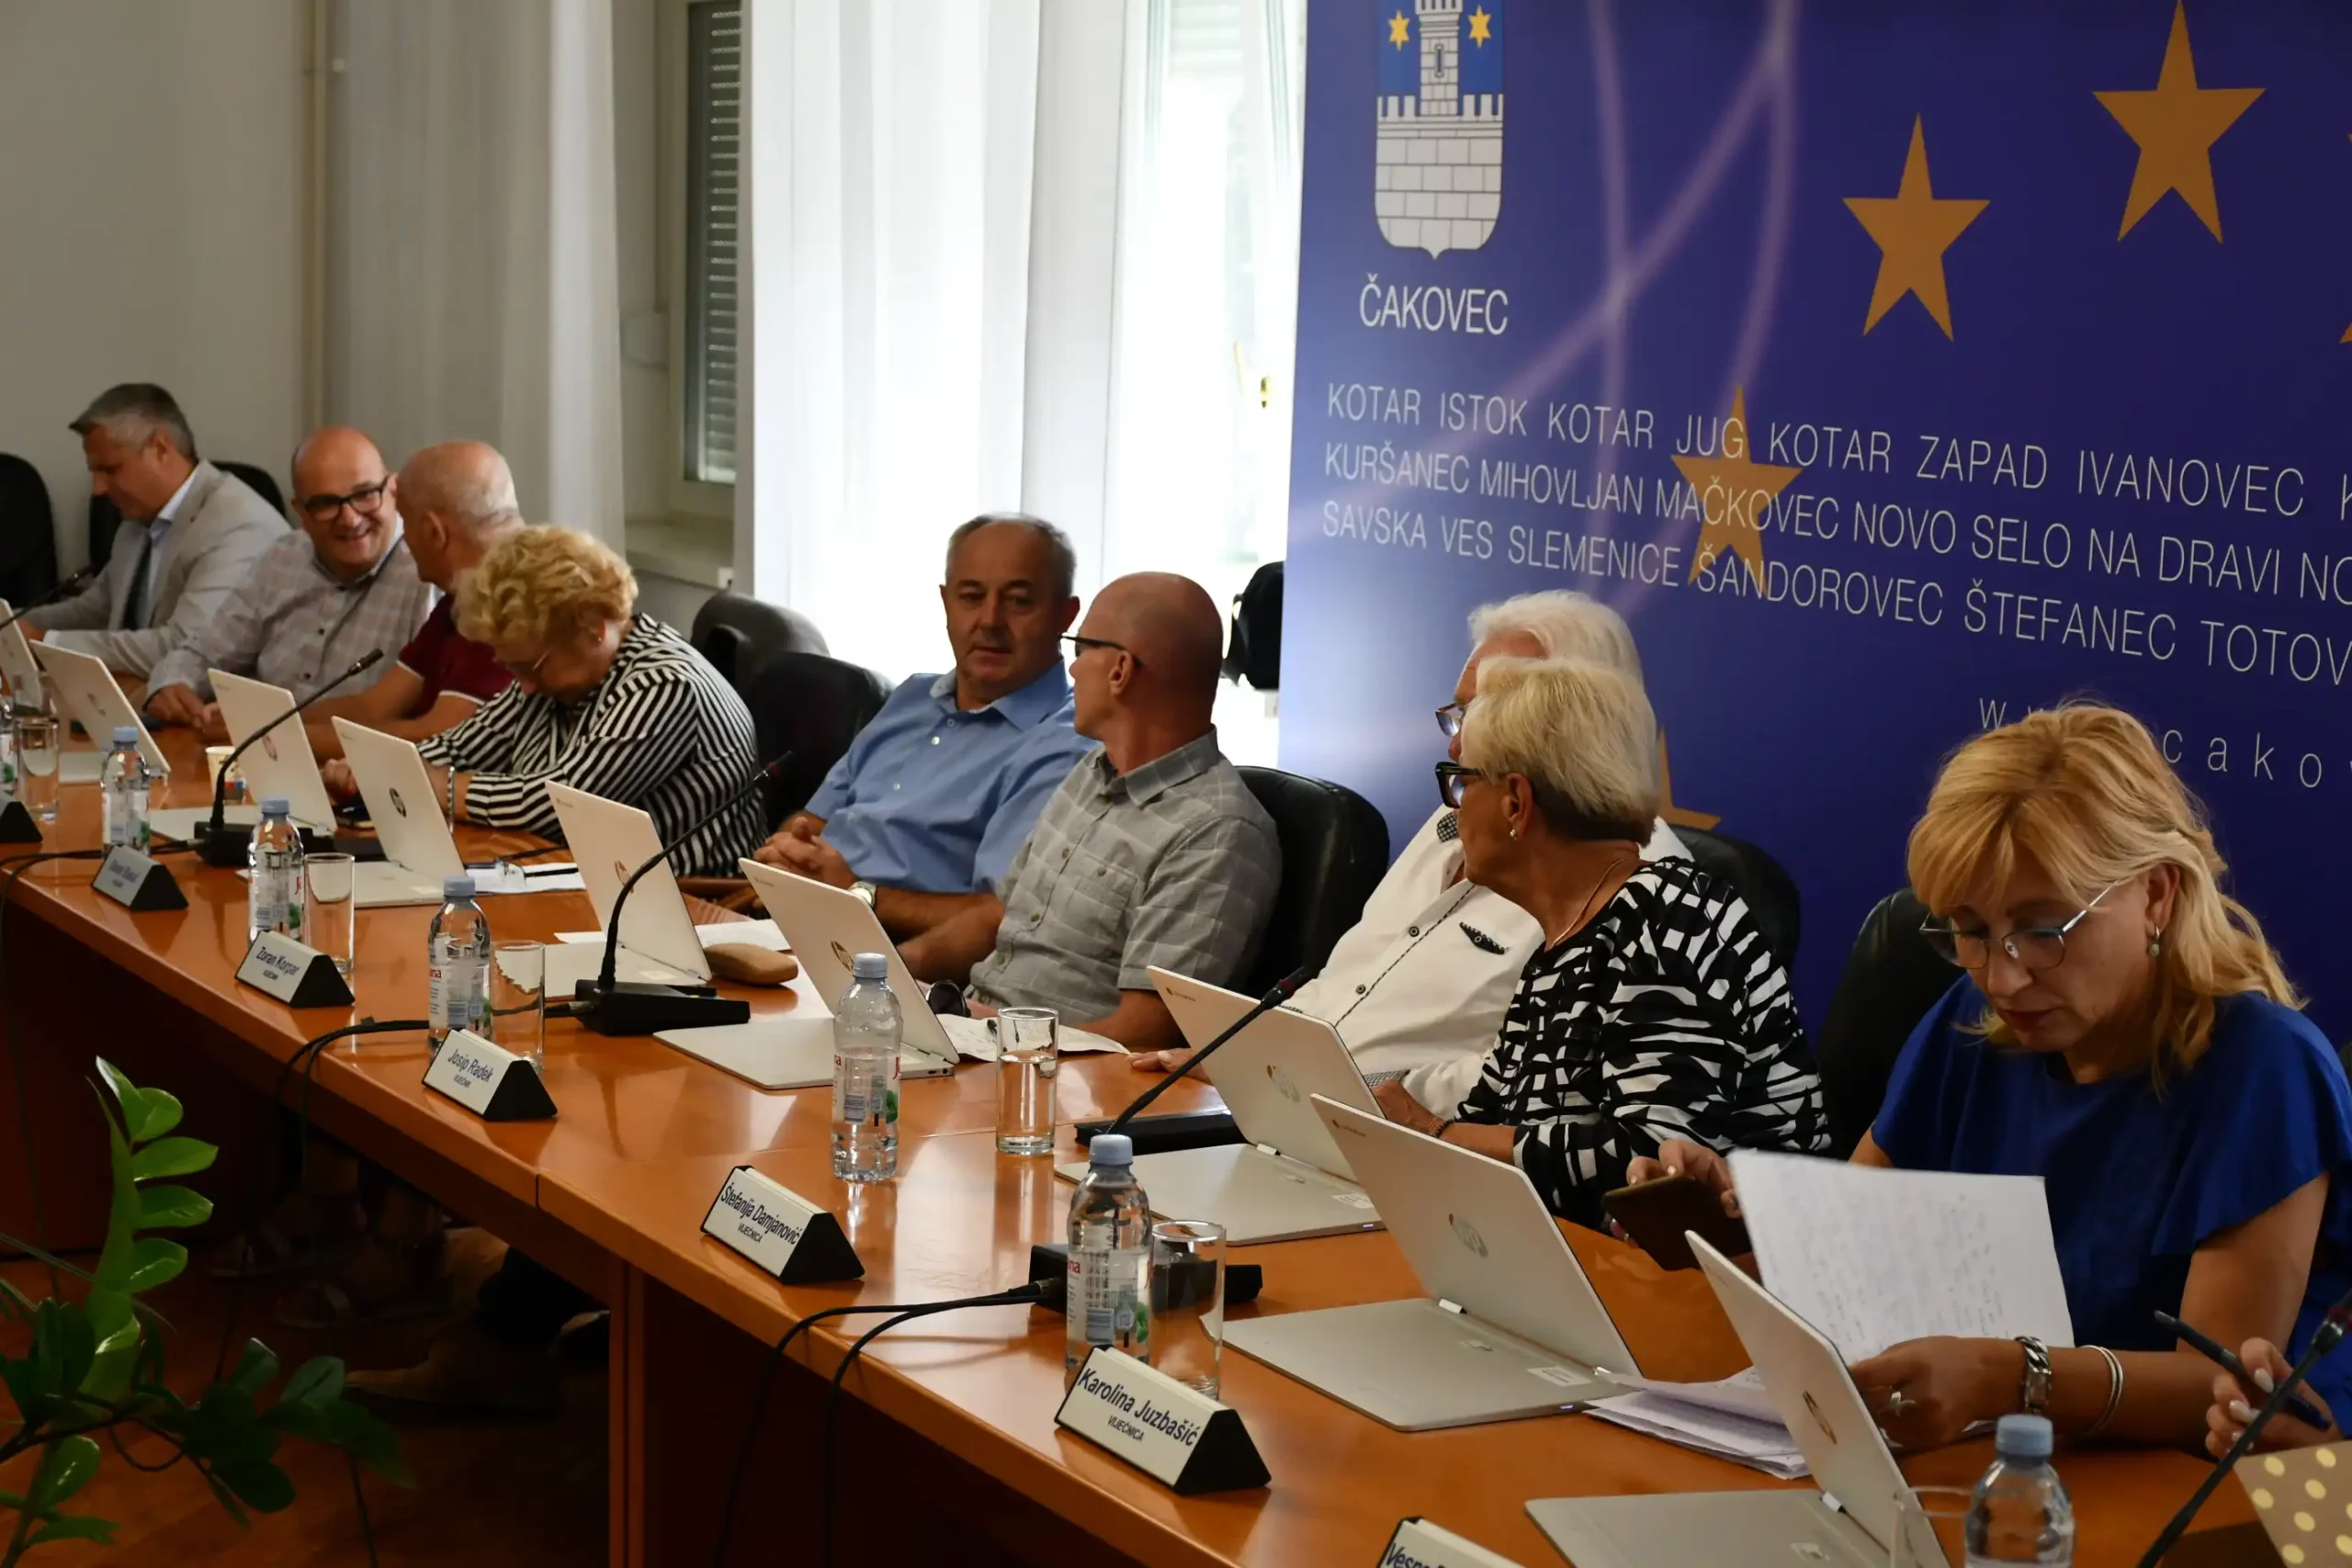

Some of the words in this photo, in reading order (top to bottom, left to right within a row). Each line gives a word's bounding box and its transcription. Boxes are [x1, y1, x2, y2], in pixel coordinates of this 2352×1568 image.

[1360, 273, 1509, 335] ČAKOVEC
[1328, 382, 1420, 425] KOTAR
[1440, 391, 1528, 437] ISTOK
[1547, 402, 1654, 450] KOTAR
[1676, 414, 1745, 460] JUG
[1770, 423, 1891, 473] KOTAR
[1917, 434, 2048, 490] ZAPAD
[2077, 450, 2304, 517] IVANOVEC
[1325, 441, 1470, 493] KURŠANEC
[1479, 458, 1644, 515] MIHOVLJAN
[1656, 474, 1839, 540] MAČKOVEC
[1853, 501, 1956, 554] NOVO
[1972, 513, 2072, 570] SELO
[2087, 527, 2142, 578] NA
[2158, 535, 2280, 595] DRAVI
[1322, 499, 1428, 549] SAVSKA
[1440, 515, 1494, 560] VES
[1508, 524, 1681, 589] SLEMENICE
[1697, 542, 1944, 626] ŠANDOROVEC
[1963, 577, 2177, 661] ŠTEFANEC
[2162, 731, 2352, 789] cako
[256, 946, 277, 965] Zoran
[448, 1049, 469, 1071] Josip
[469, 1058, 493, 1082] Radek
[721, 1182, 754, 1219] Štefanija
[753, 1204, 802, 1245] Damjanović
[1078, 1368, 1135, 1413] Karolina
[1135, 1400, 1200, 1447] Juzbašić
[1385, 1542, 1430, 1568] Ves
